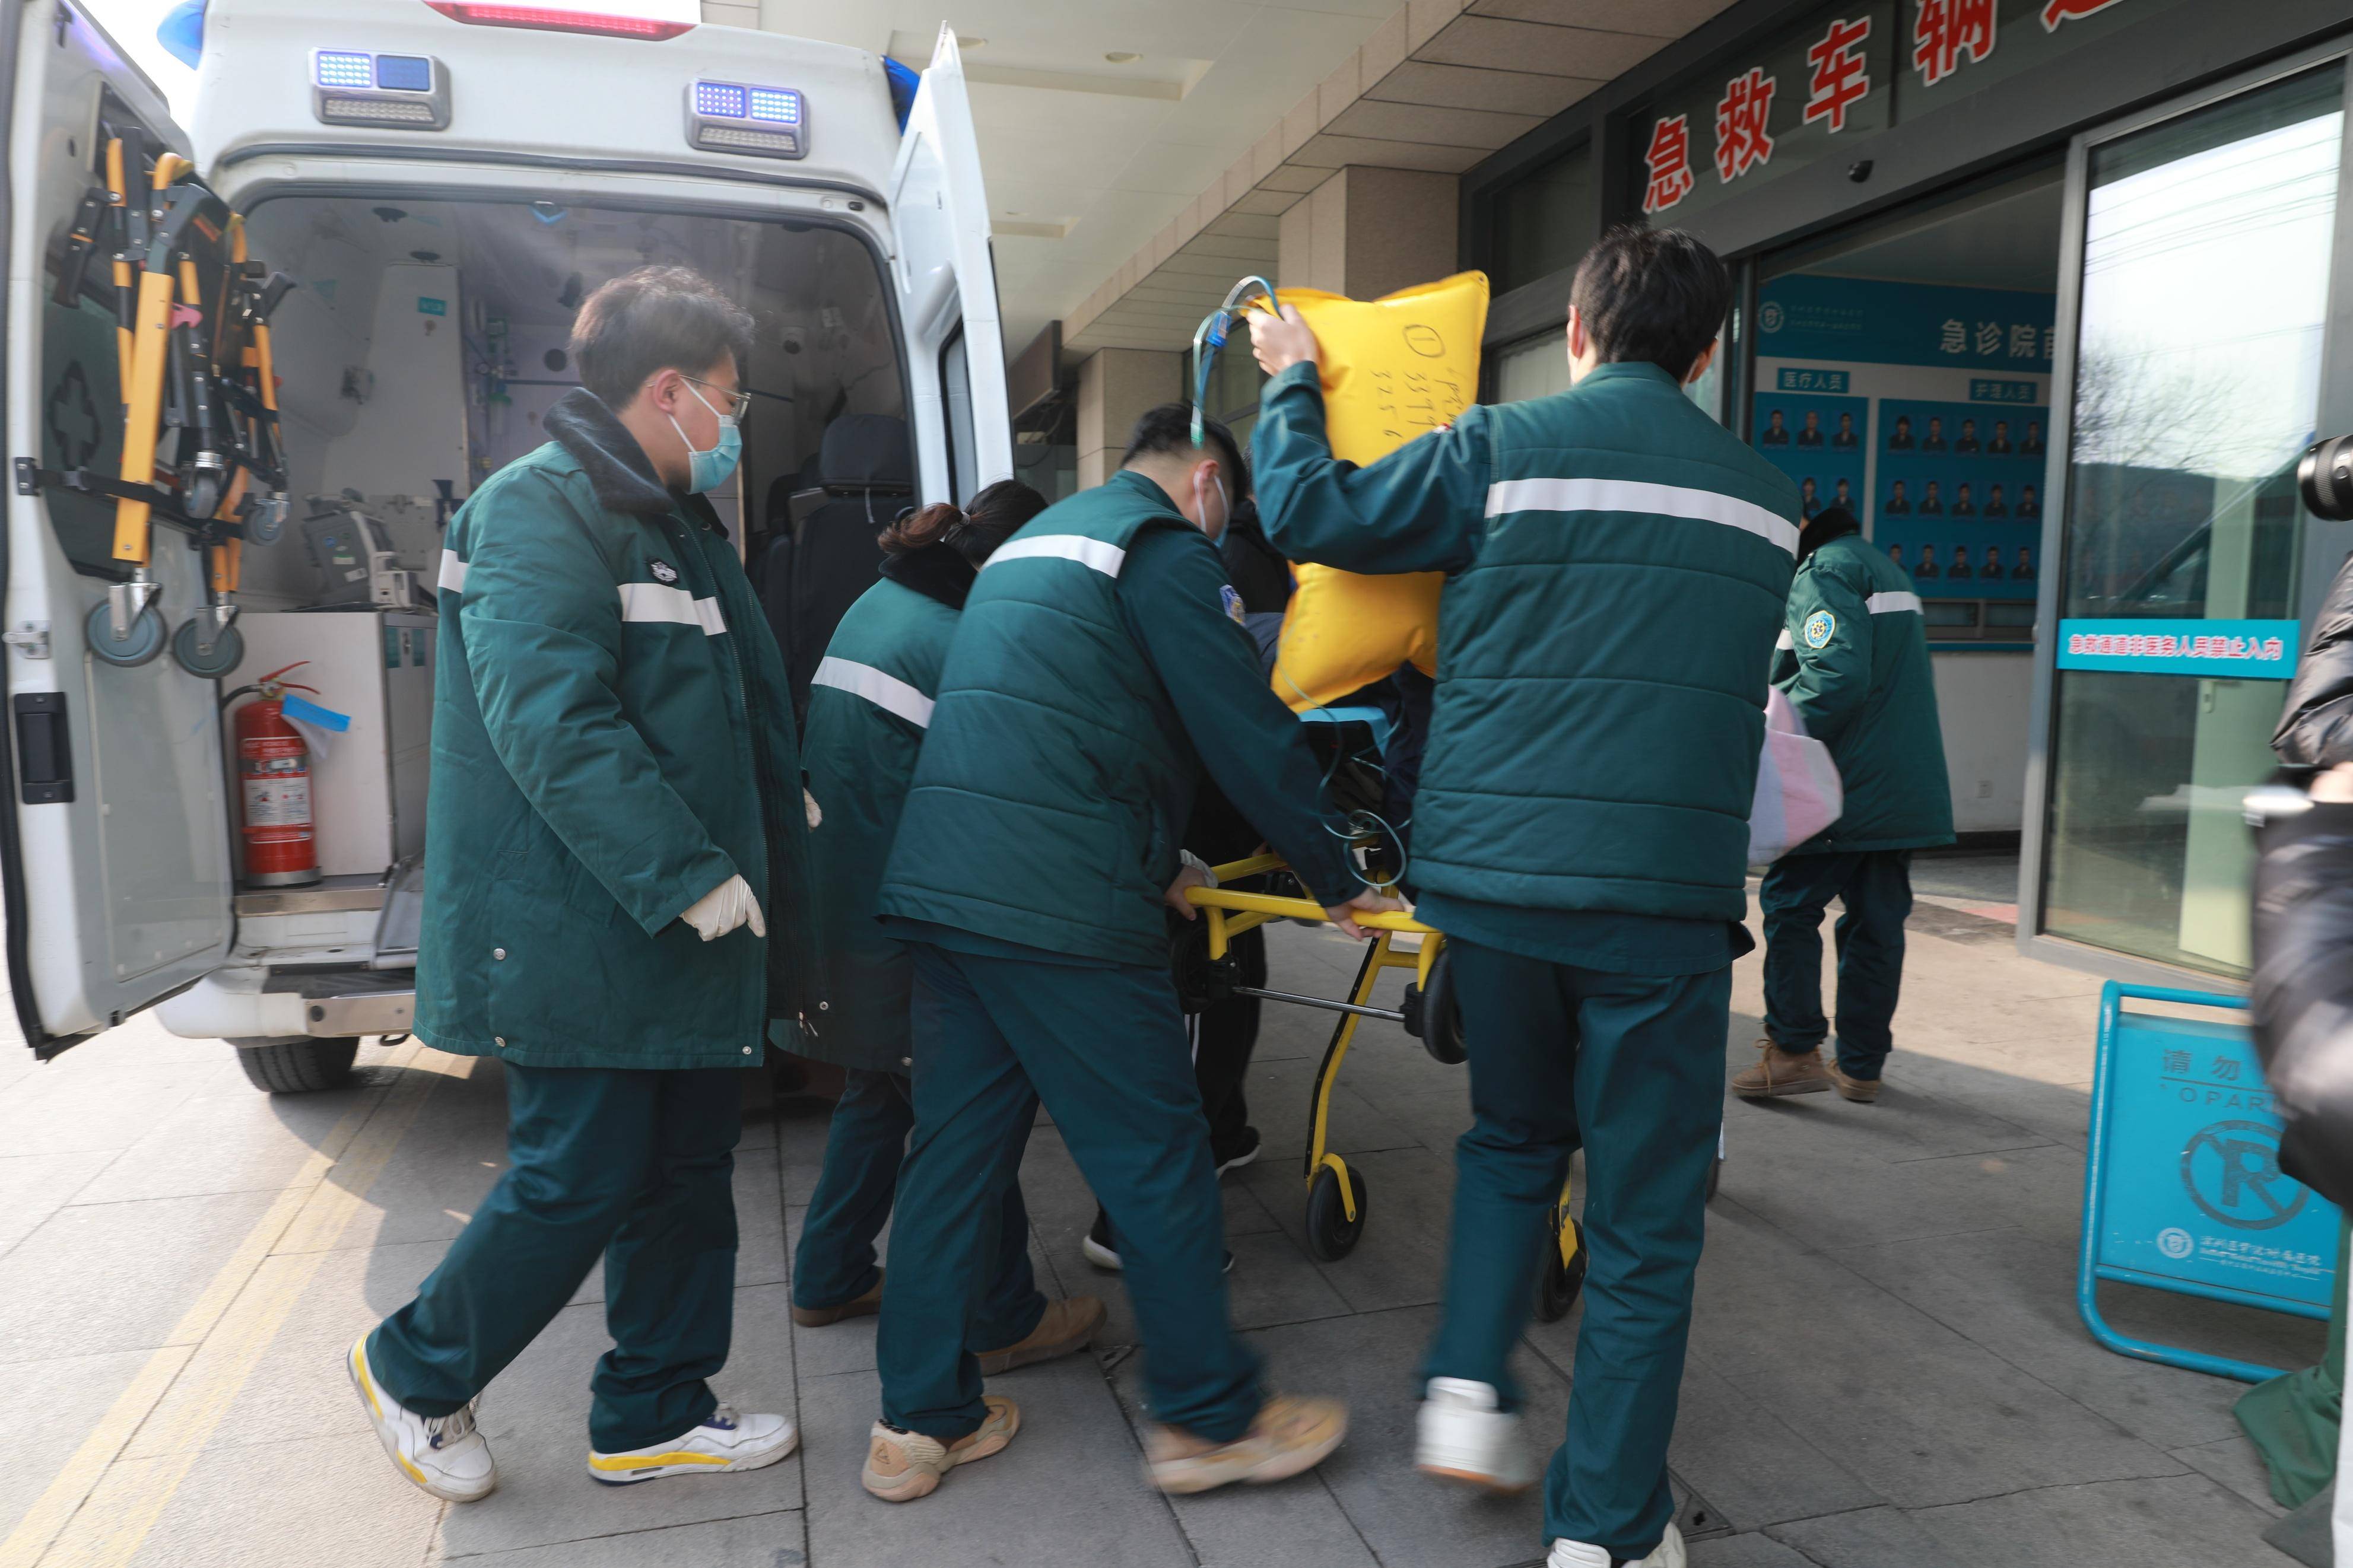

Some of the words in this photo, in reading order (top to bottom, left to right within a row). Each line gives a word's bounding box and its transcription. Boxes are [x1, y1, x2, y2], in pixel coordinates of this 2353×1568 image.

[1641, 0, 2125, 215] 急救车辆
[1784, 371, 1843, 390] 医疗人员
[2068, 634, 2283, 660] 急救通道非医务人员禁止入内
